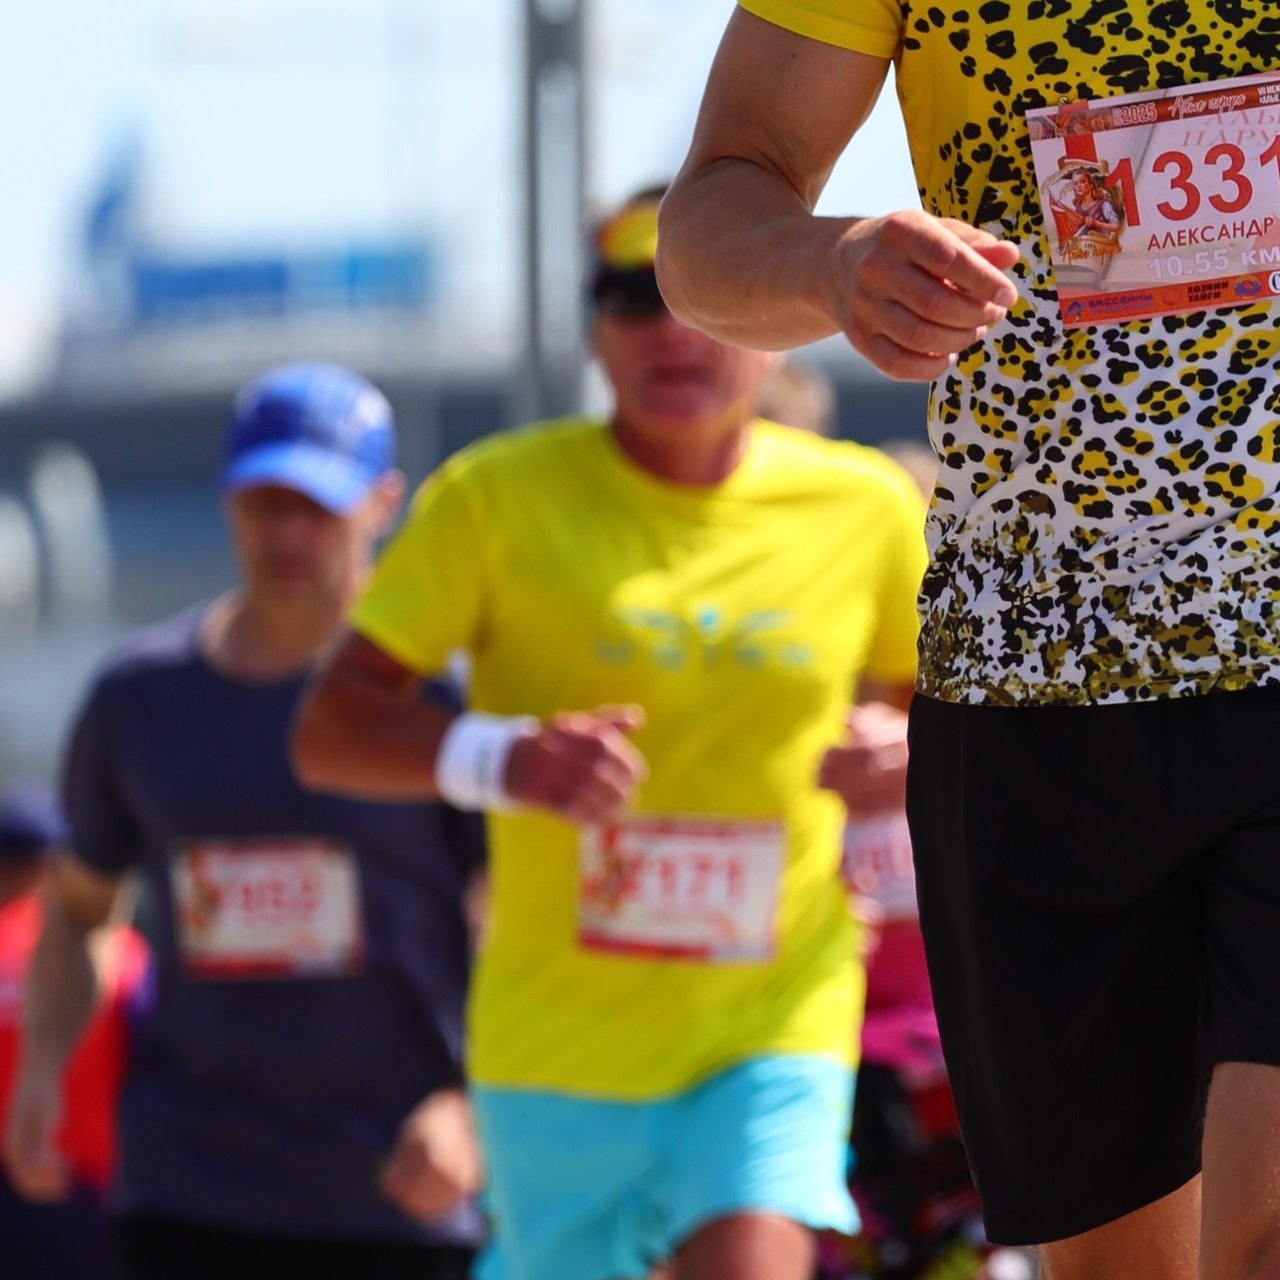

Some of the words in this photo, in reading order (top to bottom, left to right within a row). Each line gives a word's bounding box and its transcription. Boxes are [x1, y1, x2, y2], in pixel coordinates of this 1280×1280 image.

[1121, 103, 1158, 125] 2025
[1147, 217, 1274, 251] АЛЕКСАНДР
[1149, 248, 1230, 280] 10.55
[1187, 281, 1229, 294] ХОЗЯИН
